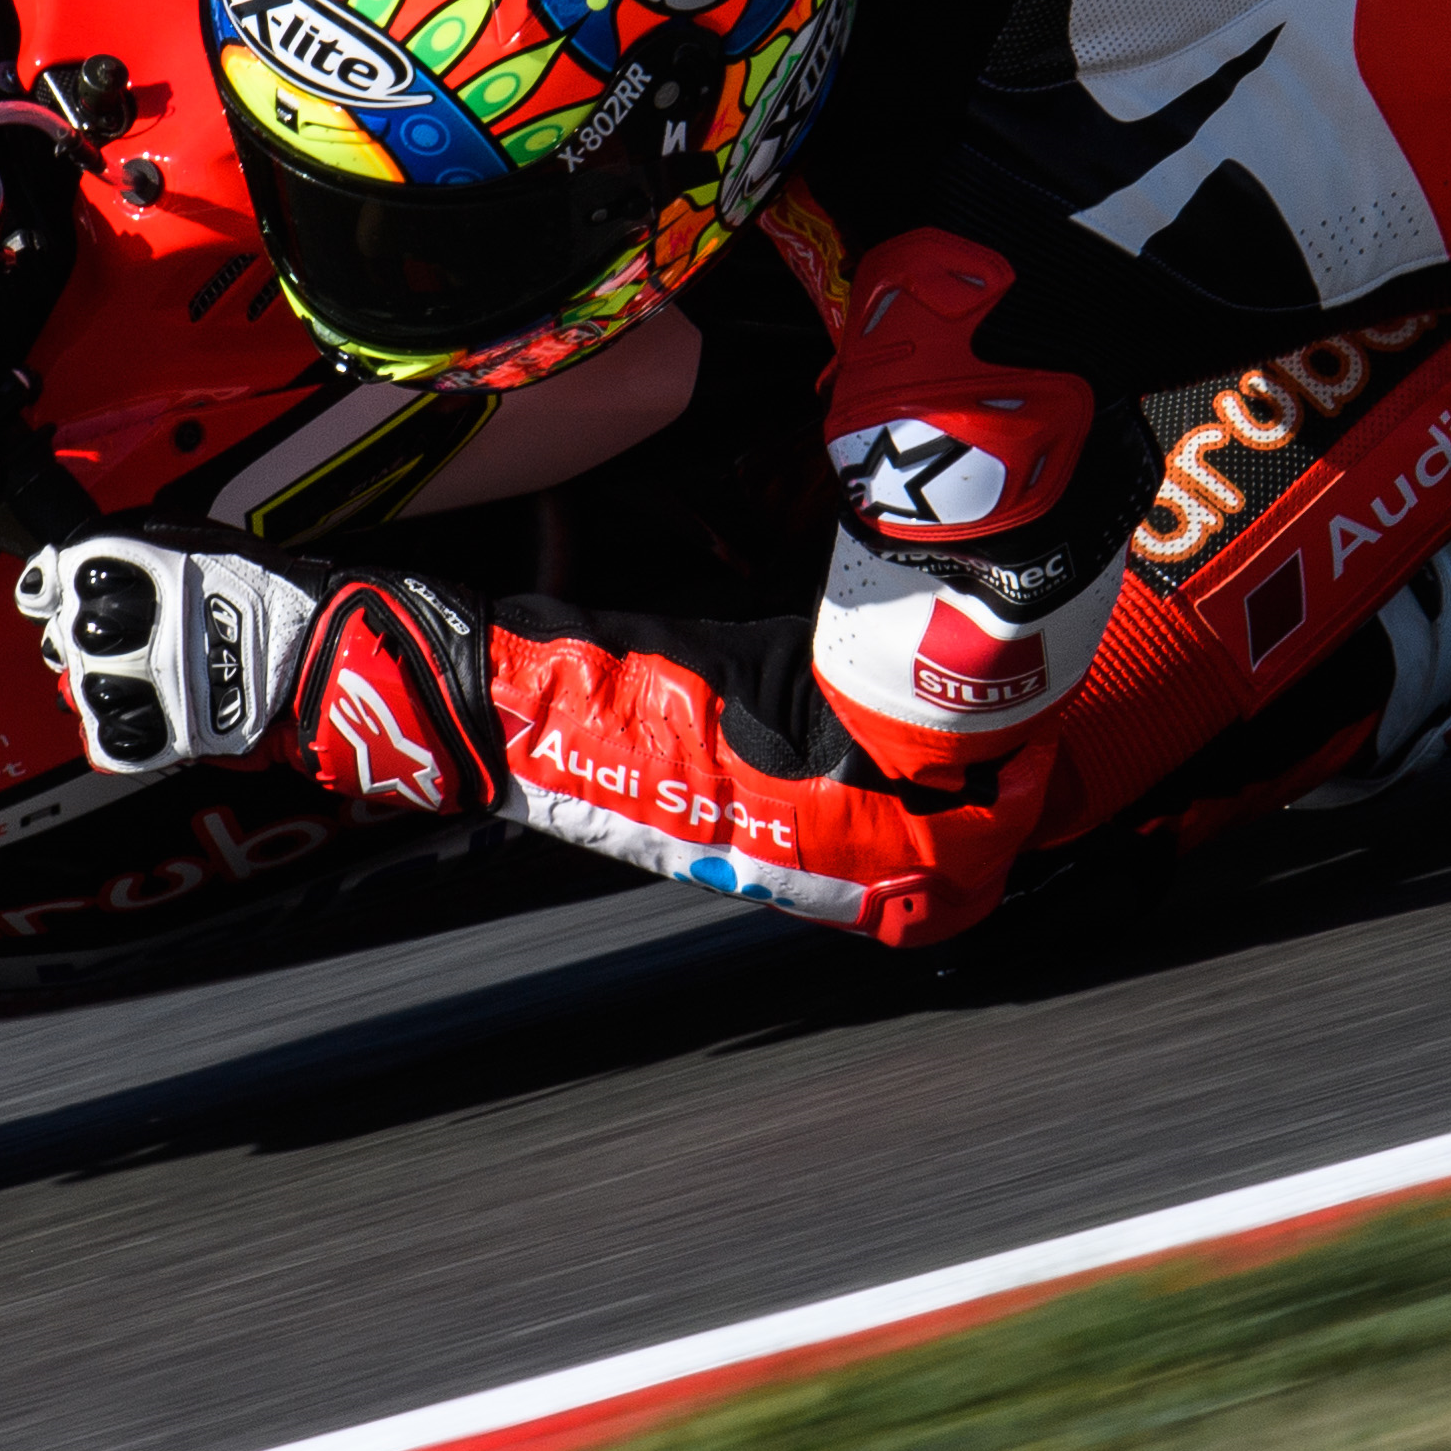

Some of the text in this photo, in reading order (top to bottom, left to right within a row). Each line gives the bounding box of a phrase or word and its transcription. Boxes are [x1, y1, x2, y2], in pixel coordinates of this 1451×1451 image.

[556, 61, 654, 174] X-802RR
[918, 669, 1044, 704] STULZ
[529, 730, 793, 849] Audi Sport
